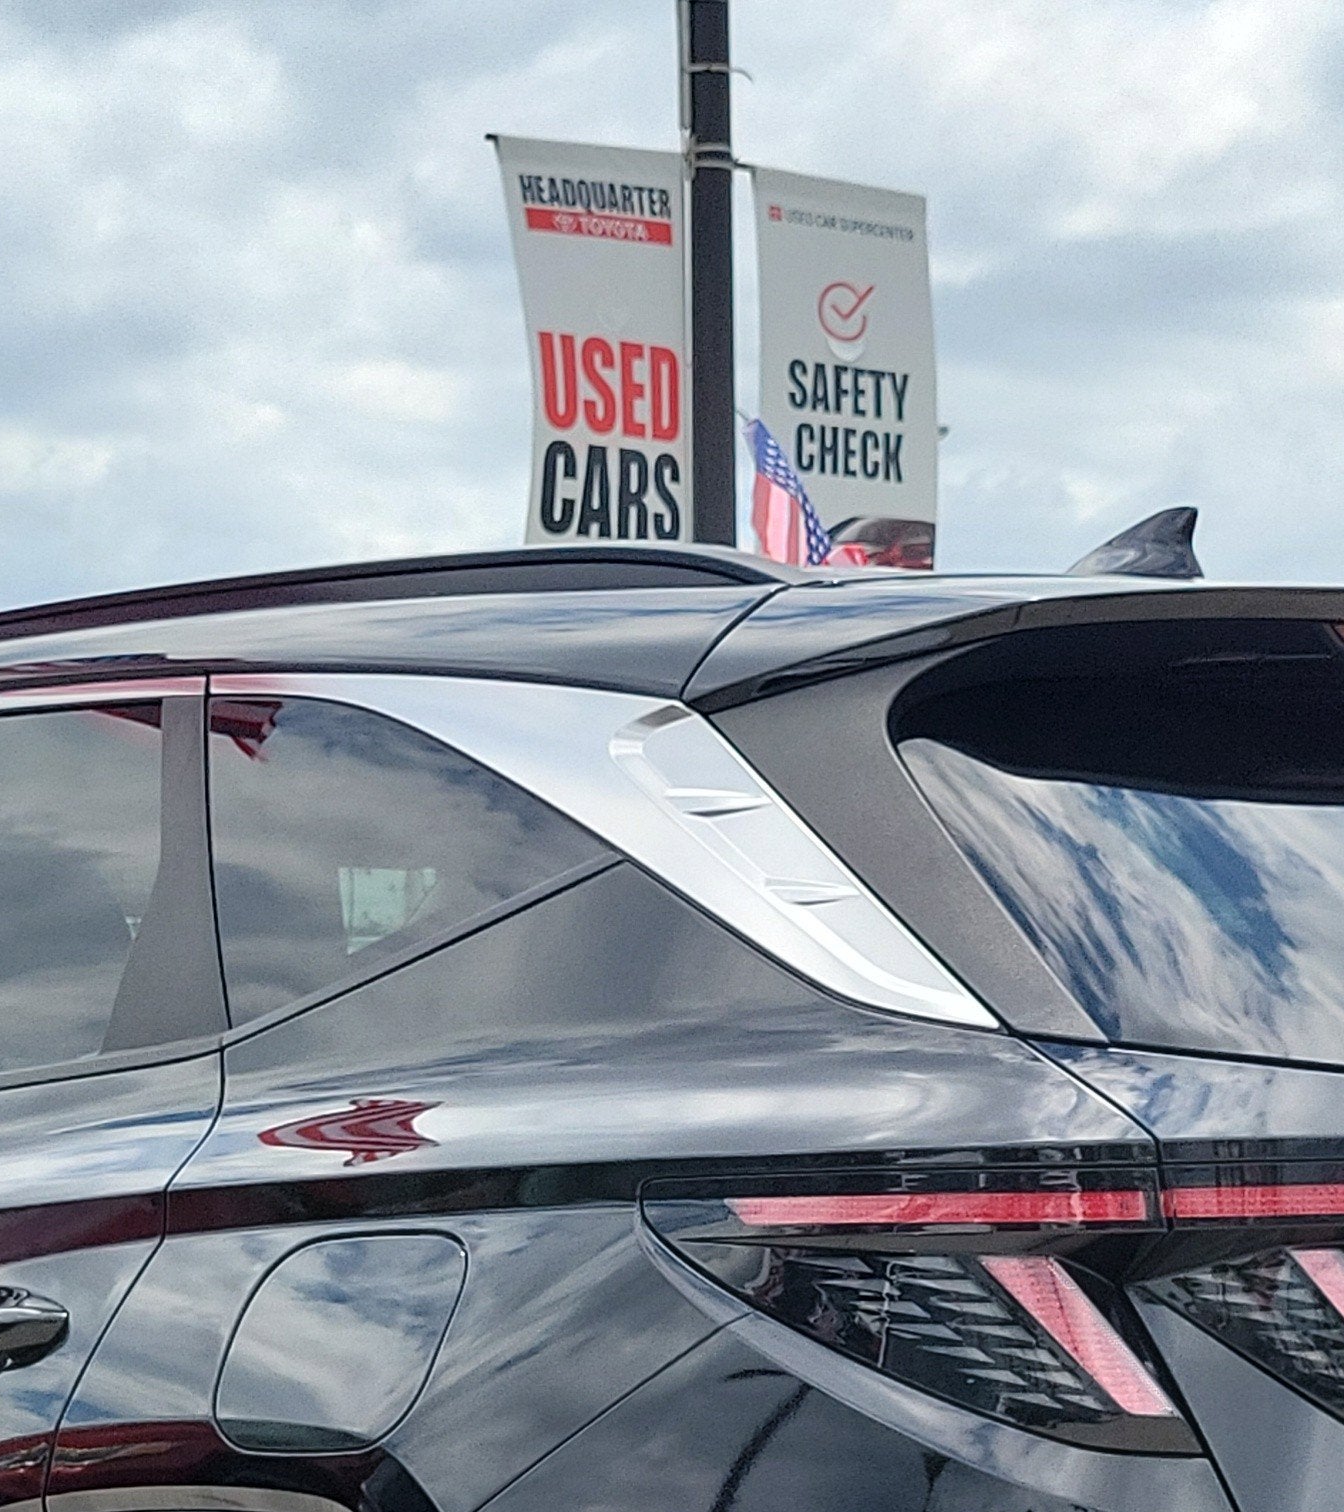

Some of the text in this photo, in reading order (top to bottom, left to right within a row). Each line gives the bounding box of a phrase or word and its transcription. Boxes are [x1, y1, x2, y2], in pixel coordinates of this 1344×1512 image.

[519, 174, 672, 219] HEADQUARTER
[580, 217, 648, 243] TOYOTA
[537, 331, 680, 442] USED
[787, 359, 910, 422] SAFETY
[796, 422, 904, 483] CHECK
[540, 440, 681, 541] CARS
